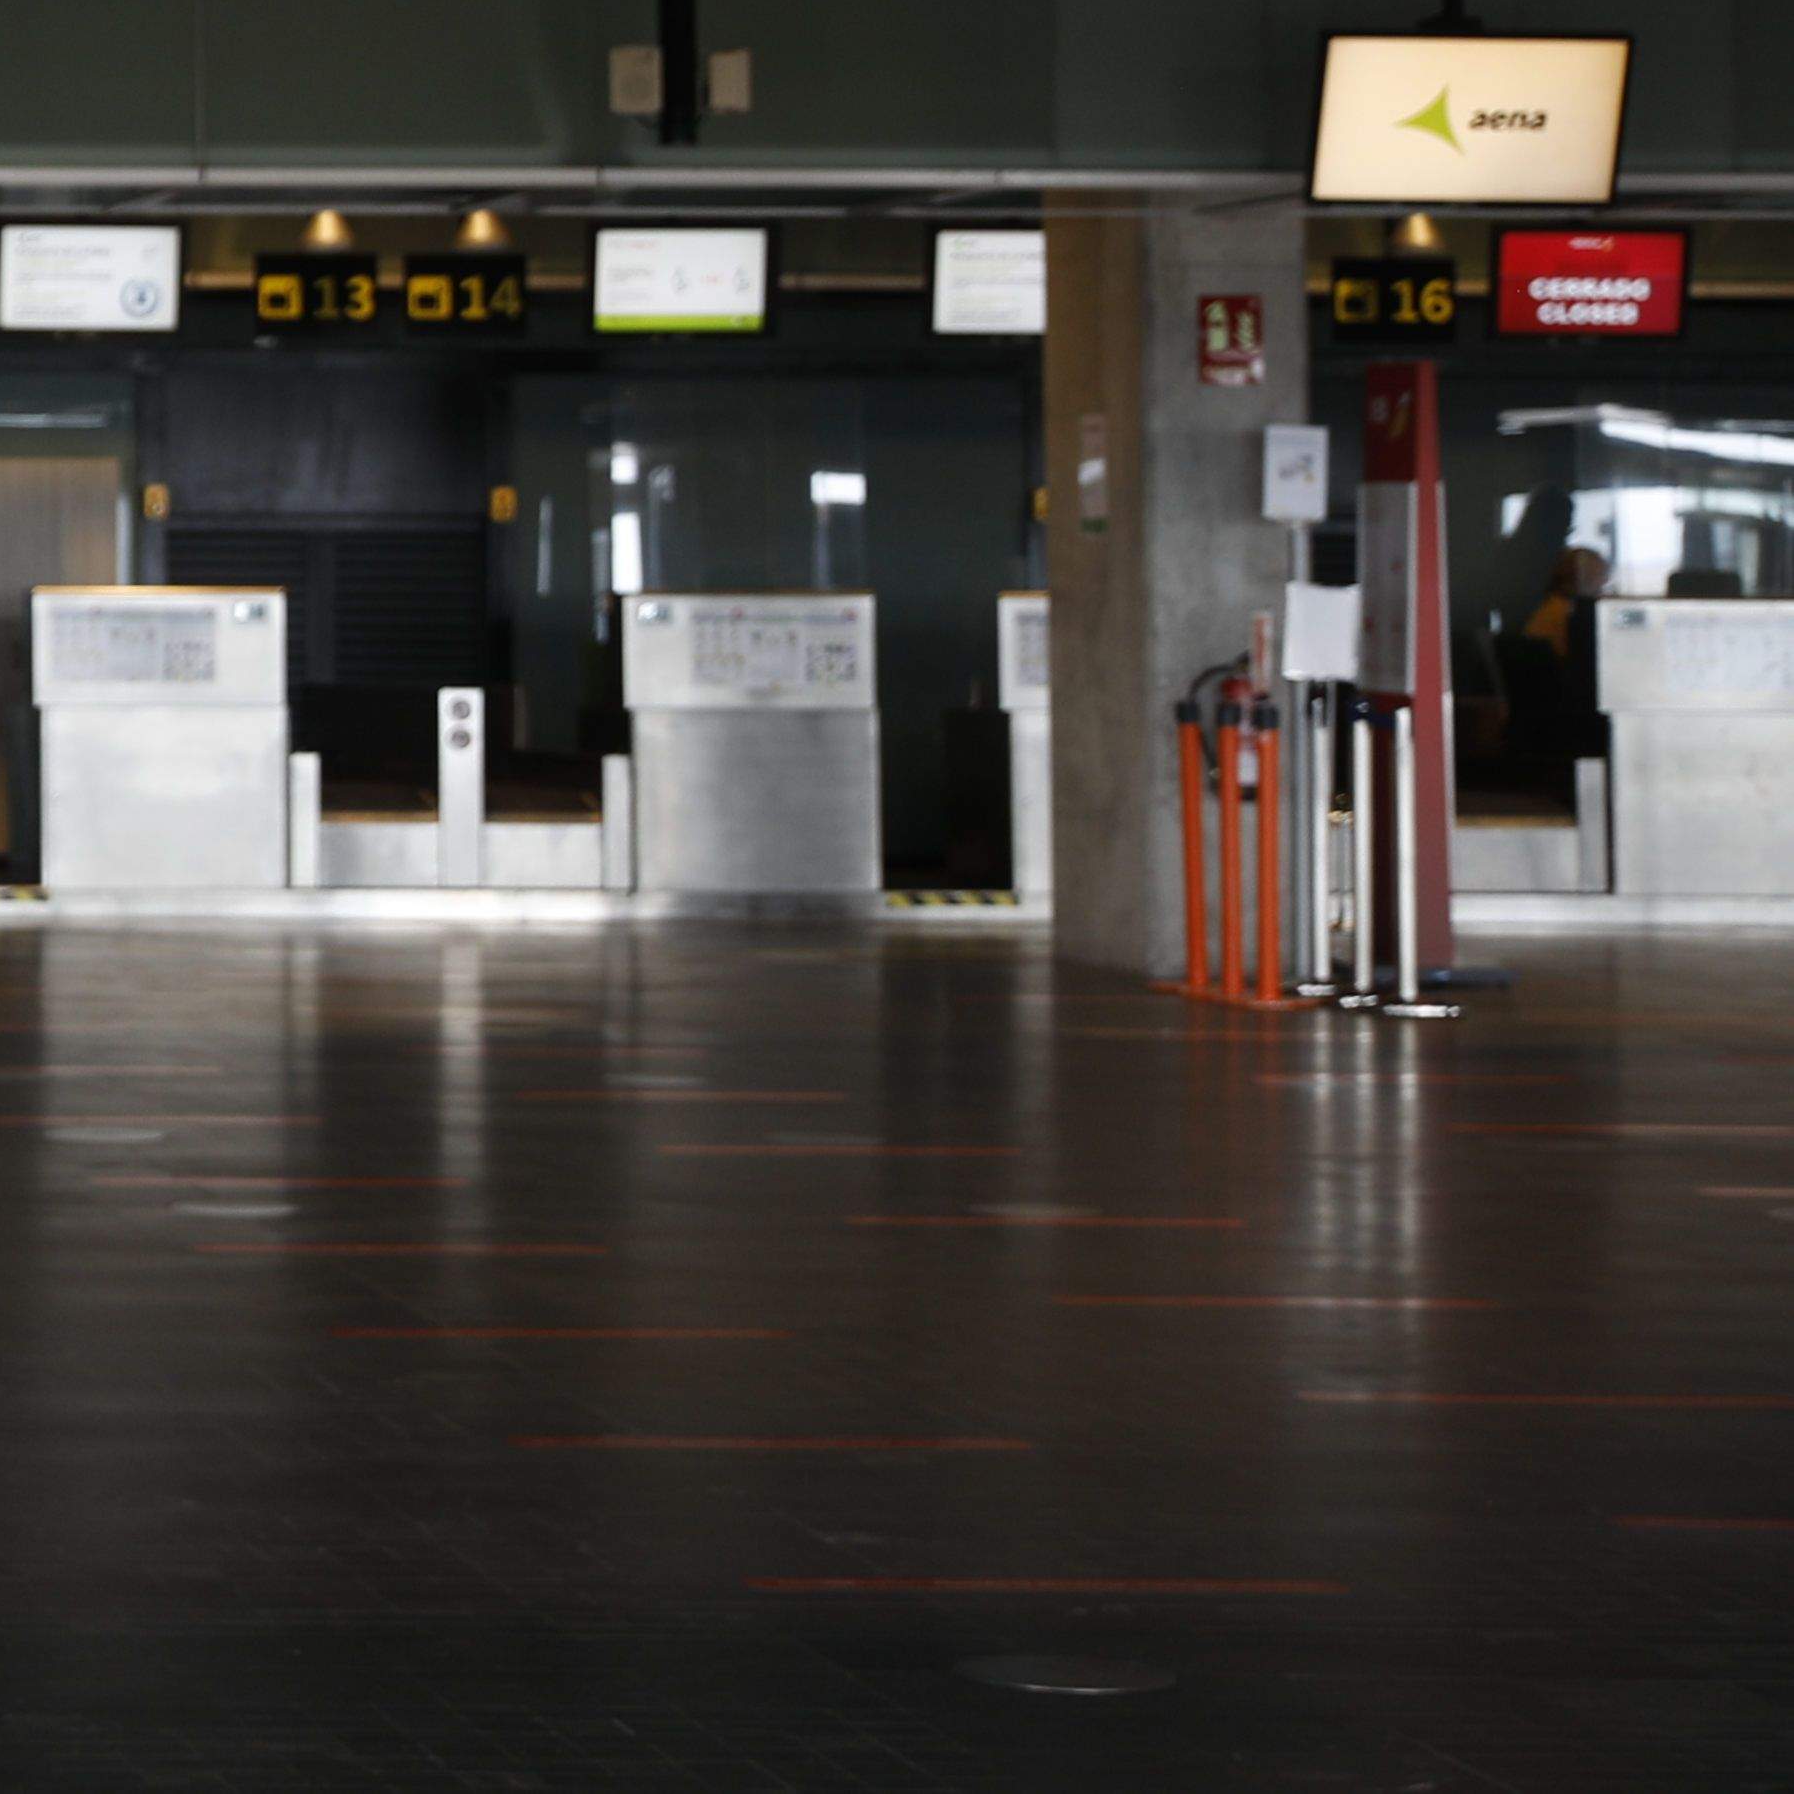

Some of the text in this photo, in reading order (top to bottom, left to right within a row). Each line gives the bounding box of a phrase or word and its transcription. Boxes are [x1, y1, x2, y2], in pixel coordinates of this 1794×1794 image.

[1468, 108, 1549, 132] aena
[312, 274, 378, 322] 13
[458, 274, 524, 322] 14
[1389, 277, 1455, 325] 16
[1536, 302, 1639, 326] CLOSED
